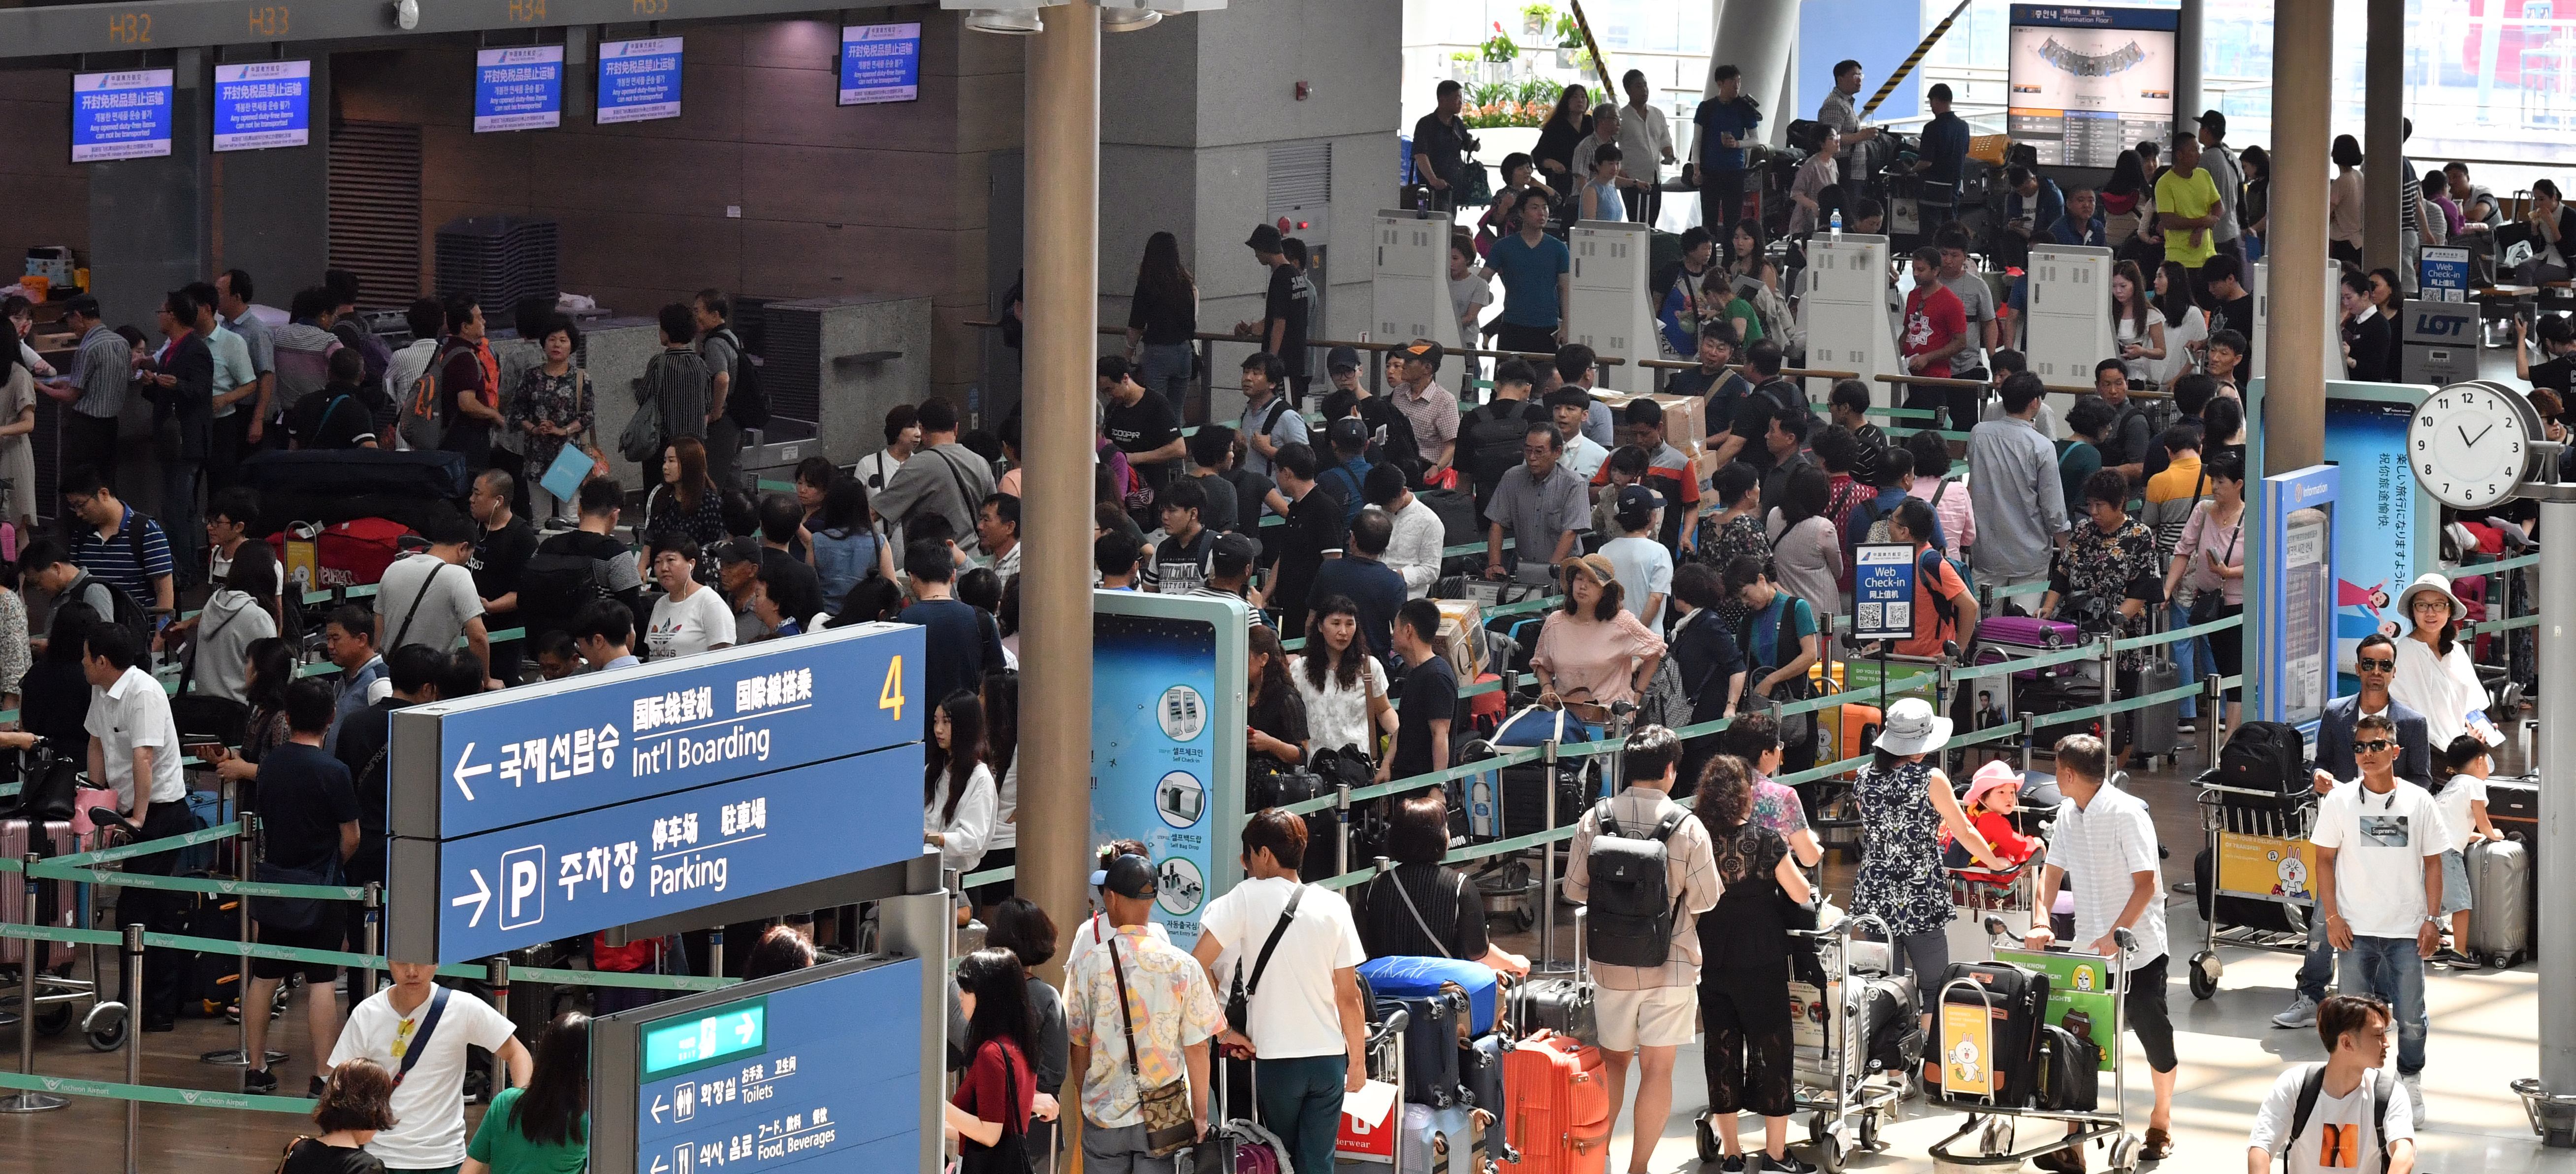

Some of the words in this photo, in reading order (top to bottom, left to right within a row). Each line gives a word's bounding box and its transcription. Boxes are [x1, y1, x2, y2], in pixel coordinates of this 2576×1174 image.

[249, 6, 289, 35] H33
[110, 14, 151, 43] H32
[224, 82, 301, 100] 开封免税品禁止运输
[82, 91, 164, 109] 开封免税品禁止运输
[2428, 270, 2460, 278] Check-in
[2415, 314, 2469, 336] LOT
[2438, 399, 2448, 408] 11
[2462, 393, 2473, 403] 12
[2488, 400, 2492, 410] 1
[2421, 417, 2433, 426] 10
[2506, 418, 2512, 427] 2
[2418, 440, 2424, 450] 9
[2512, 443, 2518, 453] 3
[2425, 464, 2431, 474] 8
[2505, 467, 2512, 477] 4
[2303, 483, 2328, 497] Information
[2378, 453, 2390, 530] 祝你旅途愉快。
[2443, 484, 2449, 493] 7
[2466, 489, 2472, 500] 6
[2489, 485, 2495, 494] 5
[1875, 566, 1896, 577] Web
[1865, 577, 1905, 587] Check-in
[1869, 590, 1899, 599] 网上值机
[879, 655, 904, 720] 4
[633, 686, 713, 733] 国际线登机
[500, 723, 619, 787] 국제선탑승
[633, 739, 671, 777] Int'l
[679, 725, 770, 768] Boarding
[1173, 748, 1203, 757] 셀프체크인
[721, 797, 767, 836] 駐車場
[652, 813, 699, 851] 停车场
[1171, 833, 1202, 844] 셀프백드랍
[1449, 836, 1466, 848] AROO
[558, 841, 638, 901] 주차장
[650, 855, 727, 897] Parking
[512, 860, 537, 918] P
[1166, 919, 1200, 931] 자동출국심
[30, 930, 51, 938] Airport
[678, 1049, 696, 1061] EXIT
[774, 1056, 796, 1075] 卫生间
[742, 1064, 764, 1083] お手洗
[88, 1086, 109, 1096] Airport
[701, 1077, 736, 1107] 화장실
[742, 1085, 773, 1104] Toilets
[200, 1096, 225, 1105] Incheon
[226, 1099, 248, 1108] Airport
[758, 1139, 784, 1161] Food,
[787, 1129, 835, 1153] Beverages
[1335, 1139, 1370, 1148] derwear
[700, 1141, 724, 1167] 식사,
[729, 1134, 752, 1161] 음료
